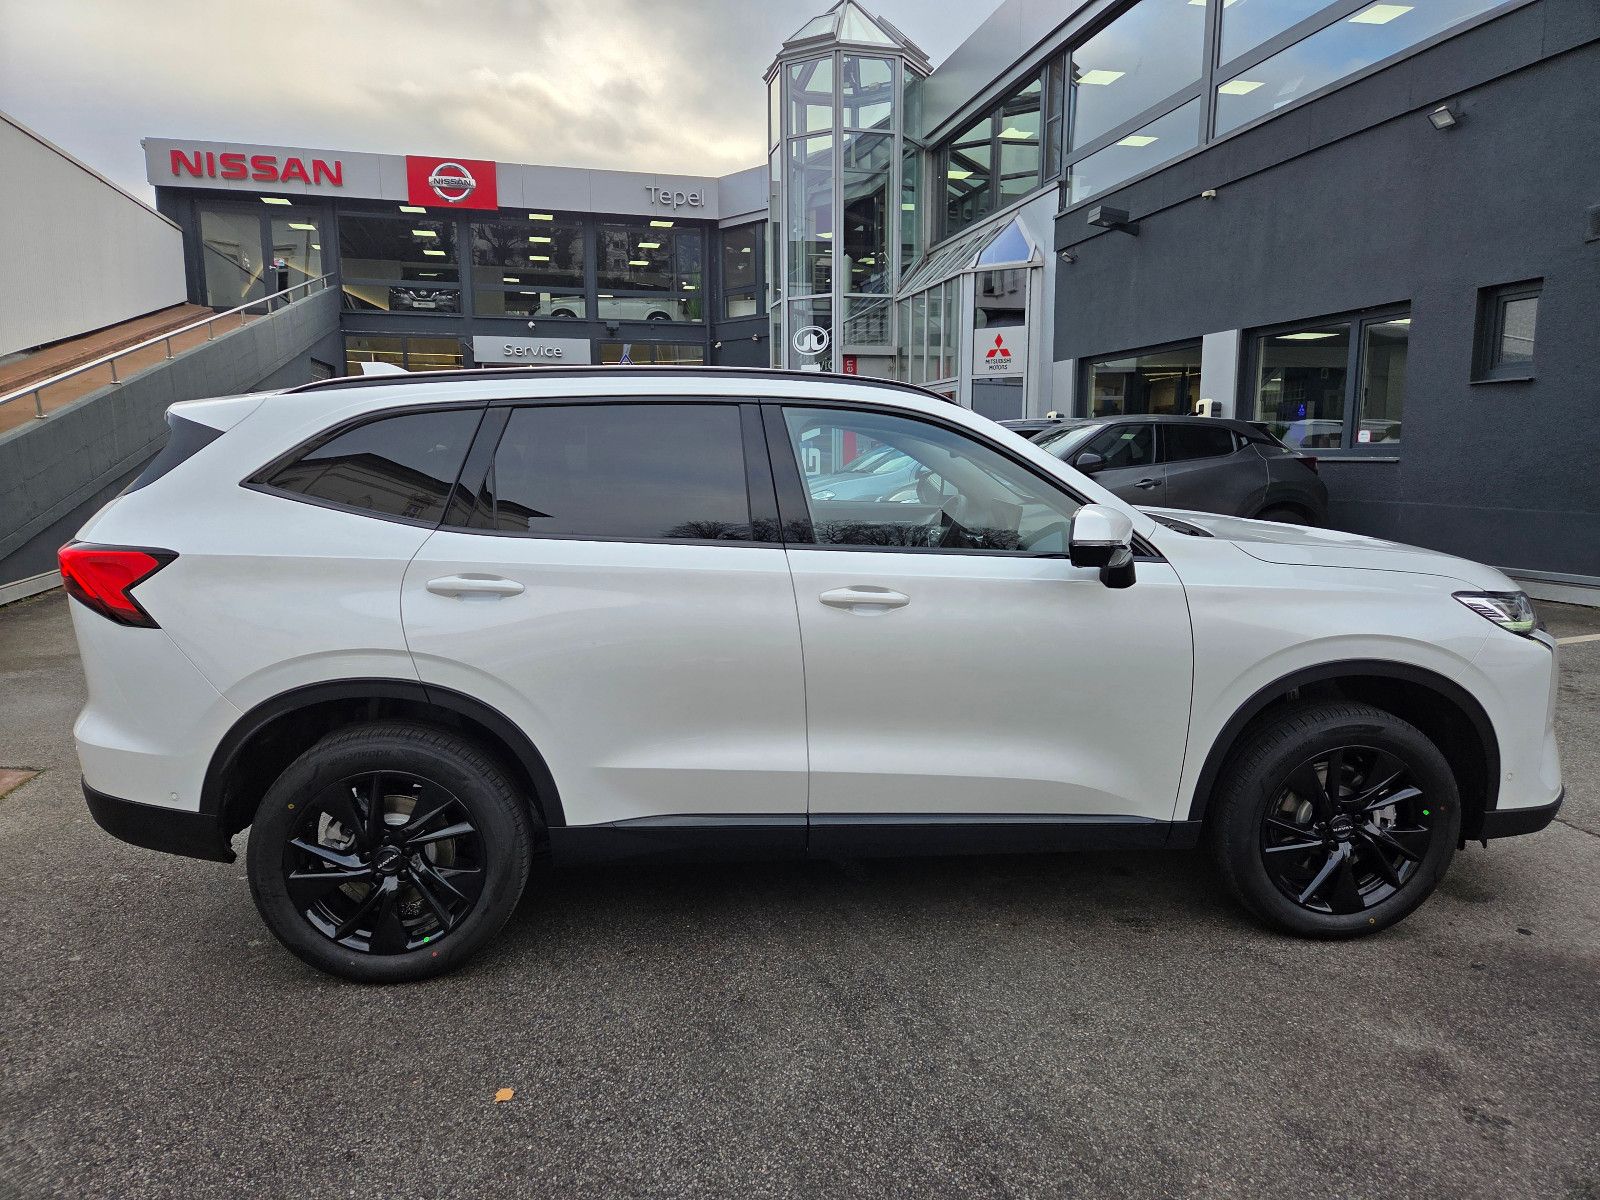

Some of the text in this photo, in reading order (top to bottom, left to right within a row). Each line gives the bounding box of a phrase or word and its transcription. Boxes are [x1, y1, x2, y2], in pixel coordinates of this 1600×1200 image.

[169, 149, 343, 187] NISSAN
[433, 178, 471, 187] NISSAN
[645, 184, 704, 209] Tepel
[503, 343, 562, 357] Service
